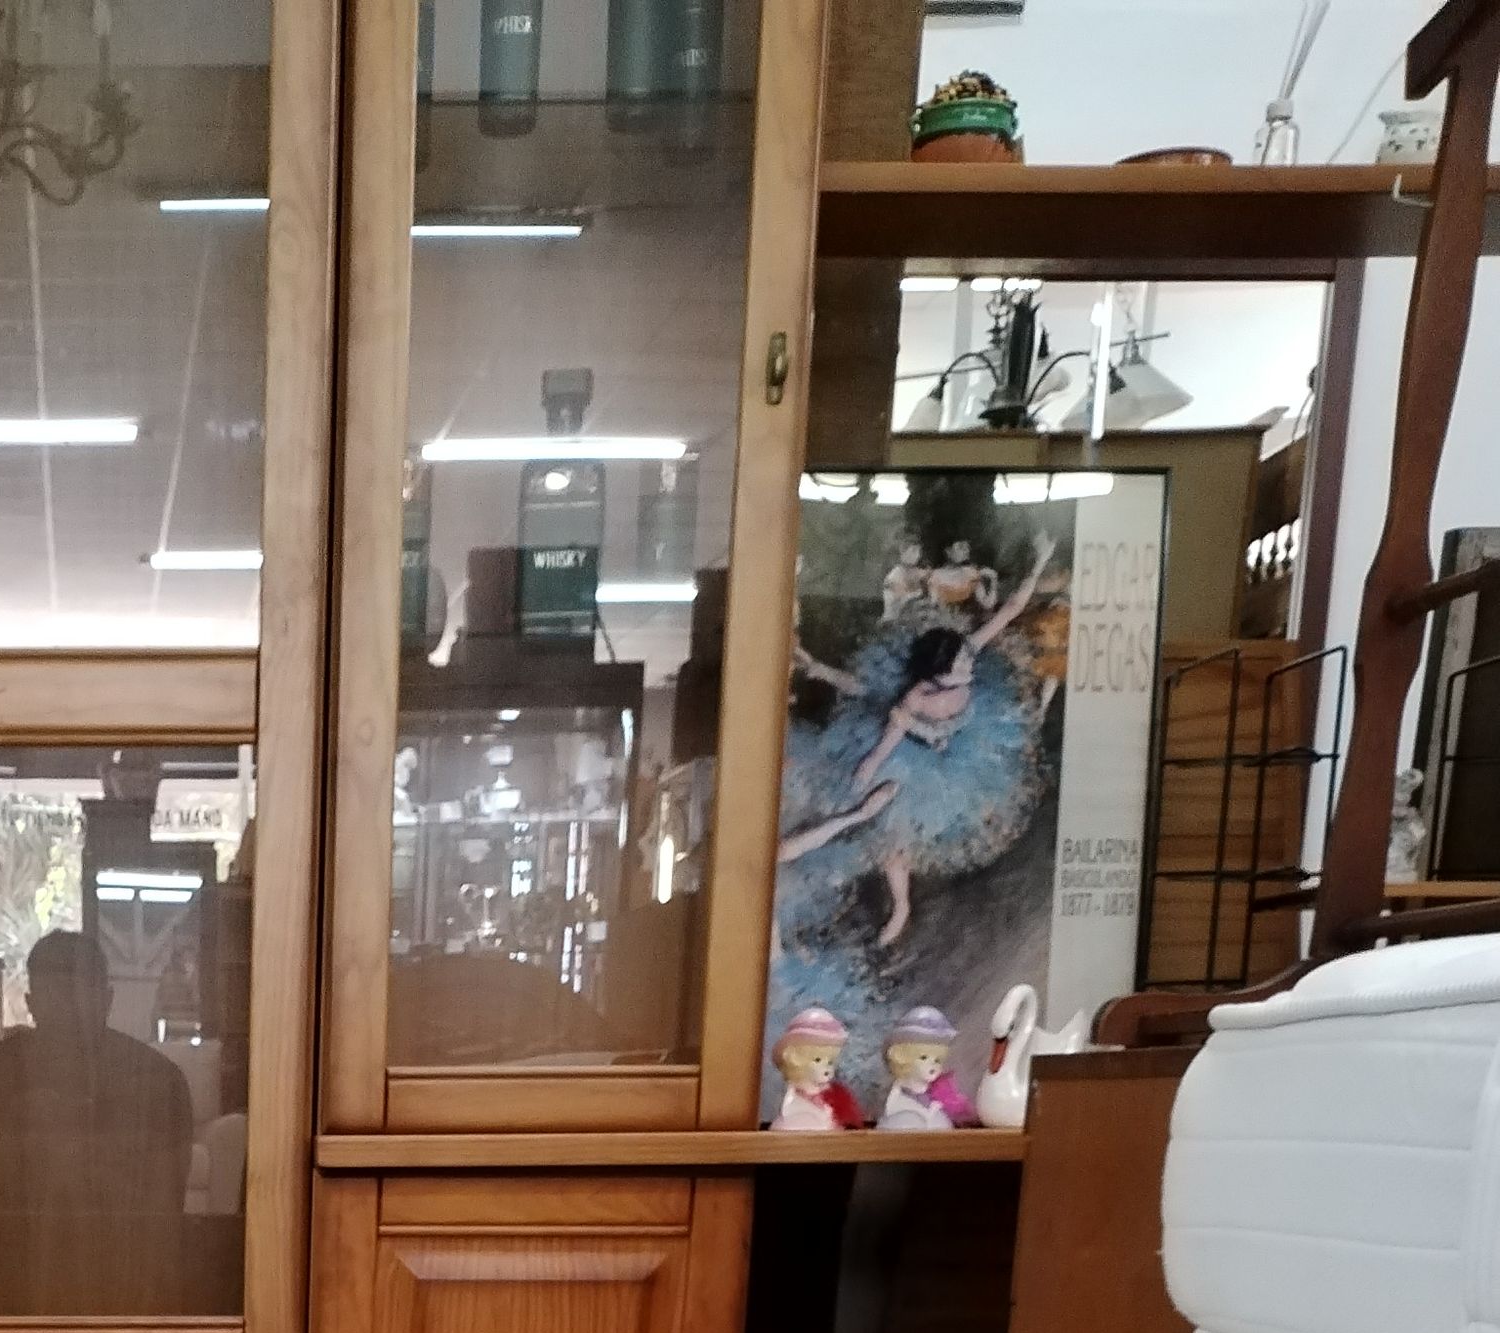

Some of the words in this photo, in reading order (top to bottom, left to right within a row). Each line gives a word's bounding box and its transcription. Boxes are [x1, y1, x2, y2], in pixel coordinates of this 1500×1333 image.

[533, 549, 586, 568] WHISKY
[1079, 542, 1156, 611] EDGAR
[1075, 623, 1151, 692] DEGAS
[1062, 838, 1139, 864] BAILARINA
